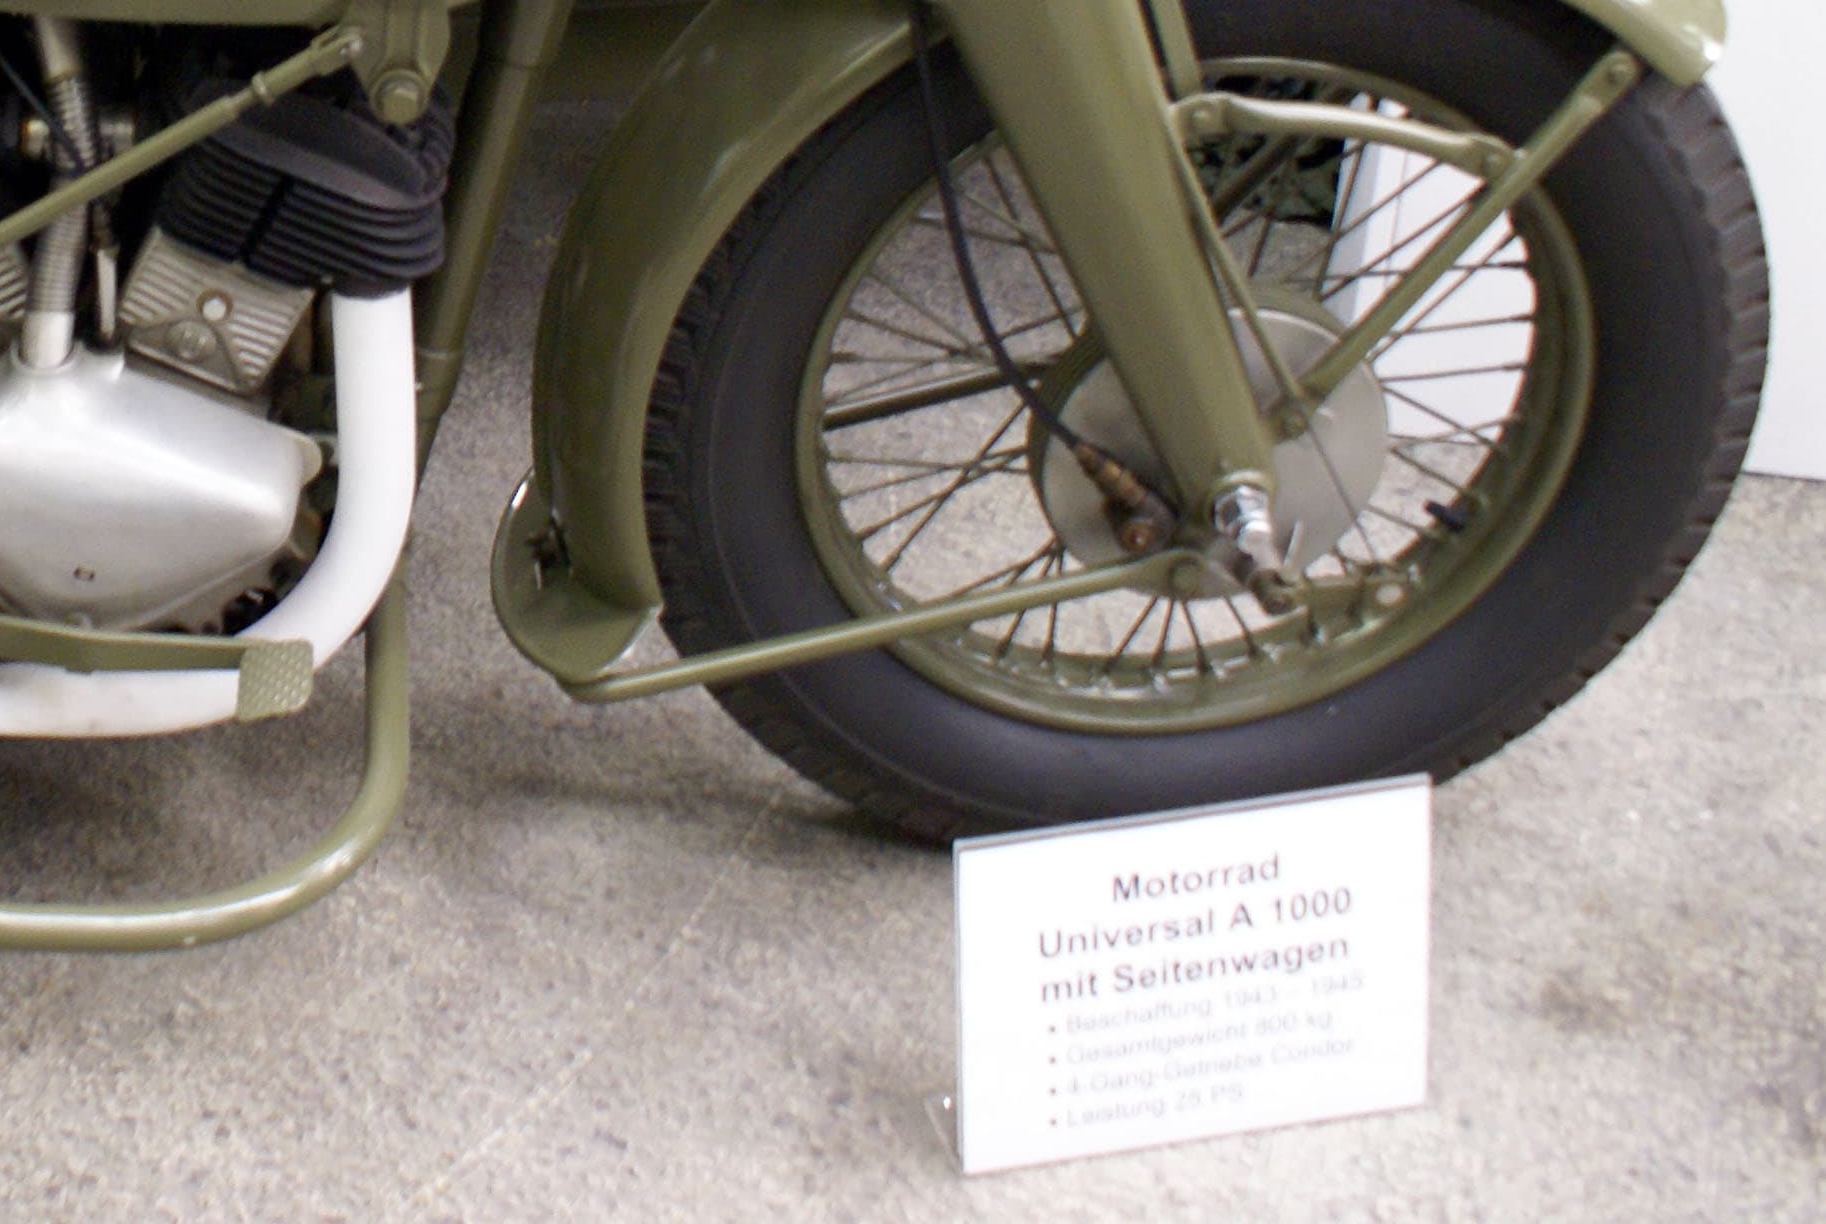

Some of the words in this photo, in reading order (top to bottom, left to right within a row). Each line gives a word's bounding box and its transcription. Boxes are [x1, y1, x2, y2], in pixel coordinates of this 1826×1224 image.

[1112, 851, 1280, 902] Motorrad
[1038, 908, 1214, 958] Universal
[1230, 902, 1254, 929] A
[1272, 885, 1352, 925] 1000
[1040, 970, 1098, 1003] mit
[1112, 937, 1349, 994] Seitenwagen
